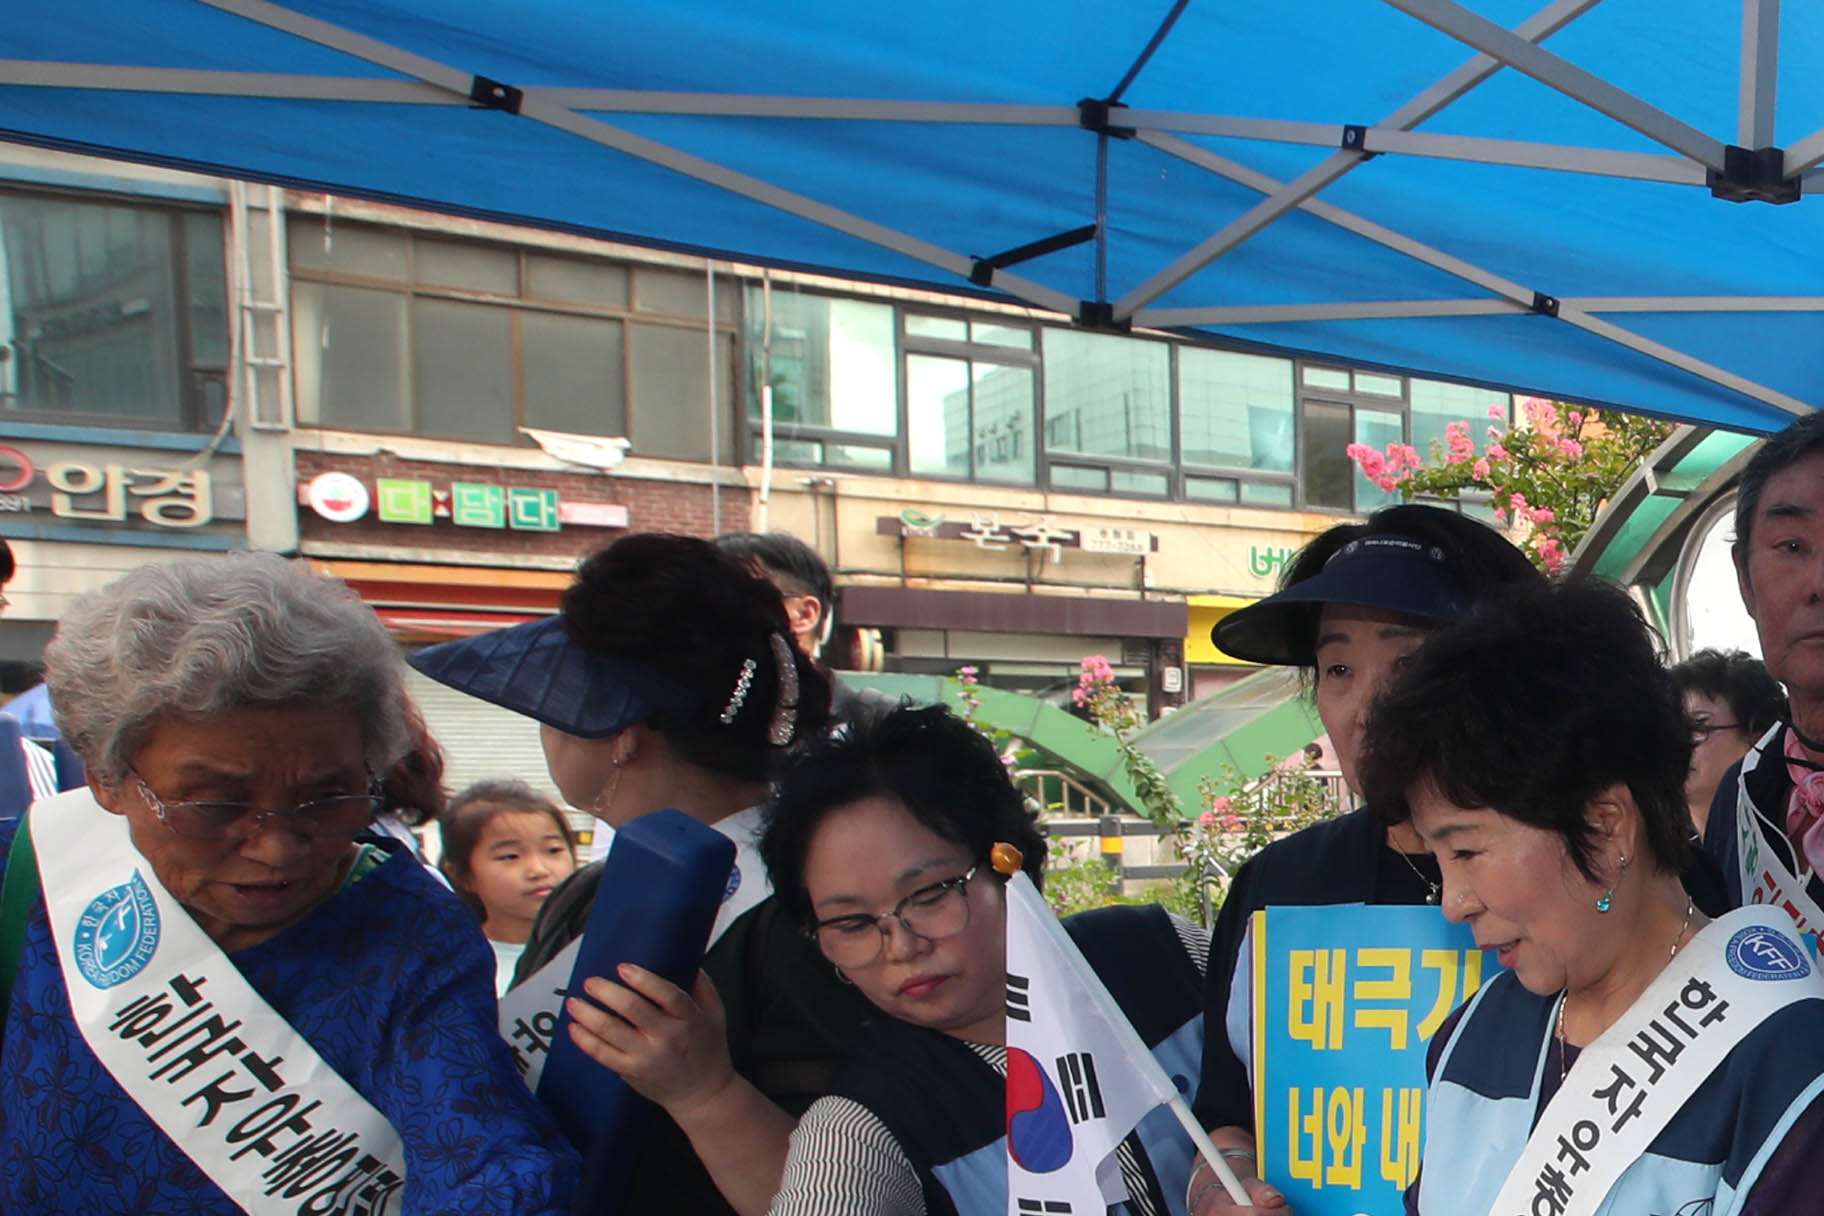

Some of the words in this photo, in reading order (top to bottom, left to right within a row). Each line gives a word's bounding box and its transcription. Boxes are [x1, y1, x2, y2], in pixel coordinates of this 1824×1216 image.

[46, 463, 213, 528] 안경
[960, 511, 1074, 564] 본죽
[1744, 935, 1794, 969] KFF
[1288, 948, 1483, 1051] 태극기
[1288, 1085, 1366, 1191] 너와
[1380, 1087, 1424, 1191] 내
